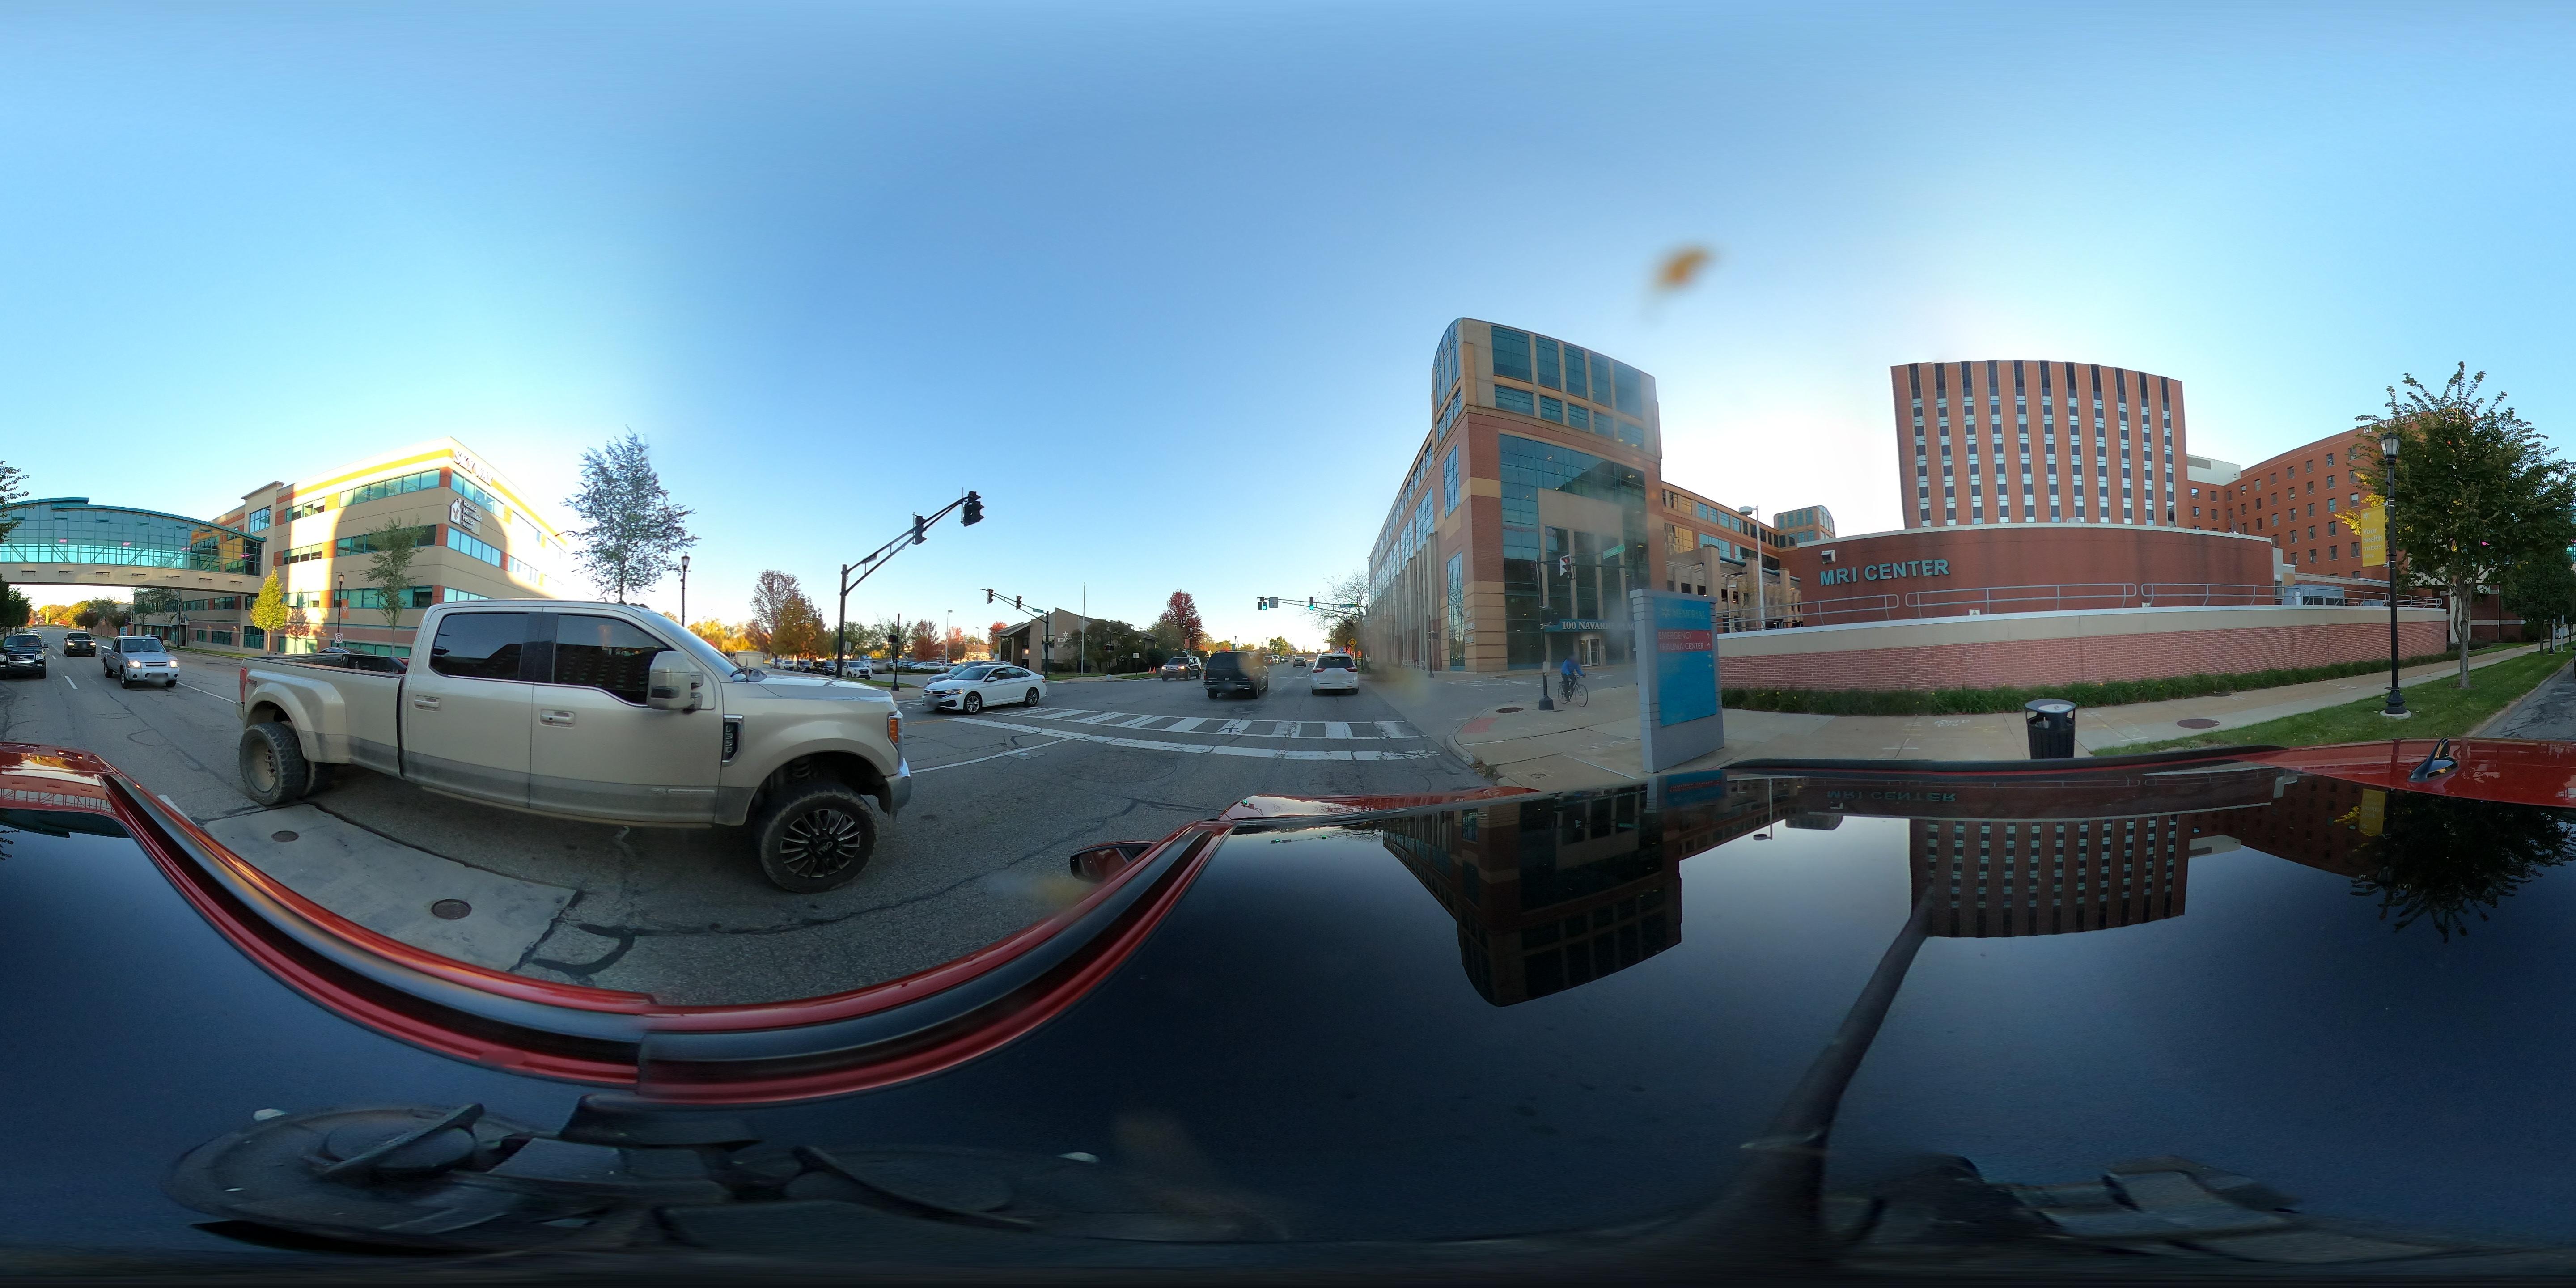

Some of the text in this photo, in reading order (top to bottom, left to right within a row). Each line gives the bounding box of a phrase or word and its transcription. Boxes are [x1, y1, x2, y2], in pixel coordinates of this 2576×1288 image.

[463, 500, 477, 513] Ronald
[462, 515, 475, 525] House
[2364, 534, 2382, 543] health
[1820, 559, 1950, 586] MRI CENTER
[1563, 621, 1576, 630] 100
[1659, 643, 1684, 651] TRAUMA
